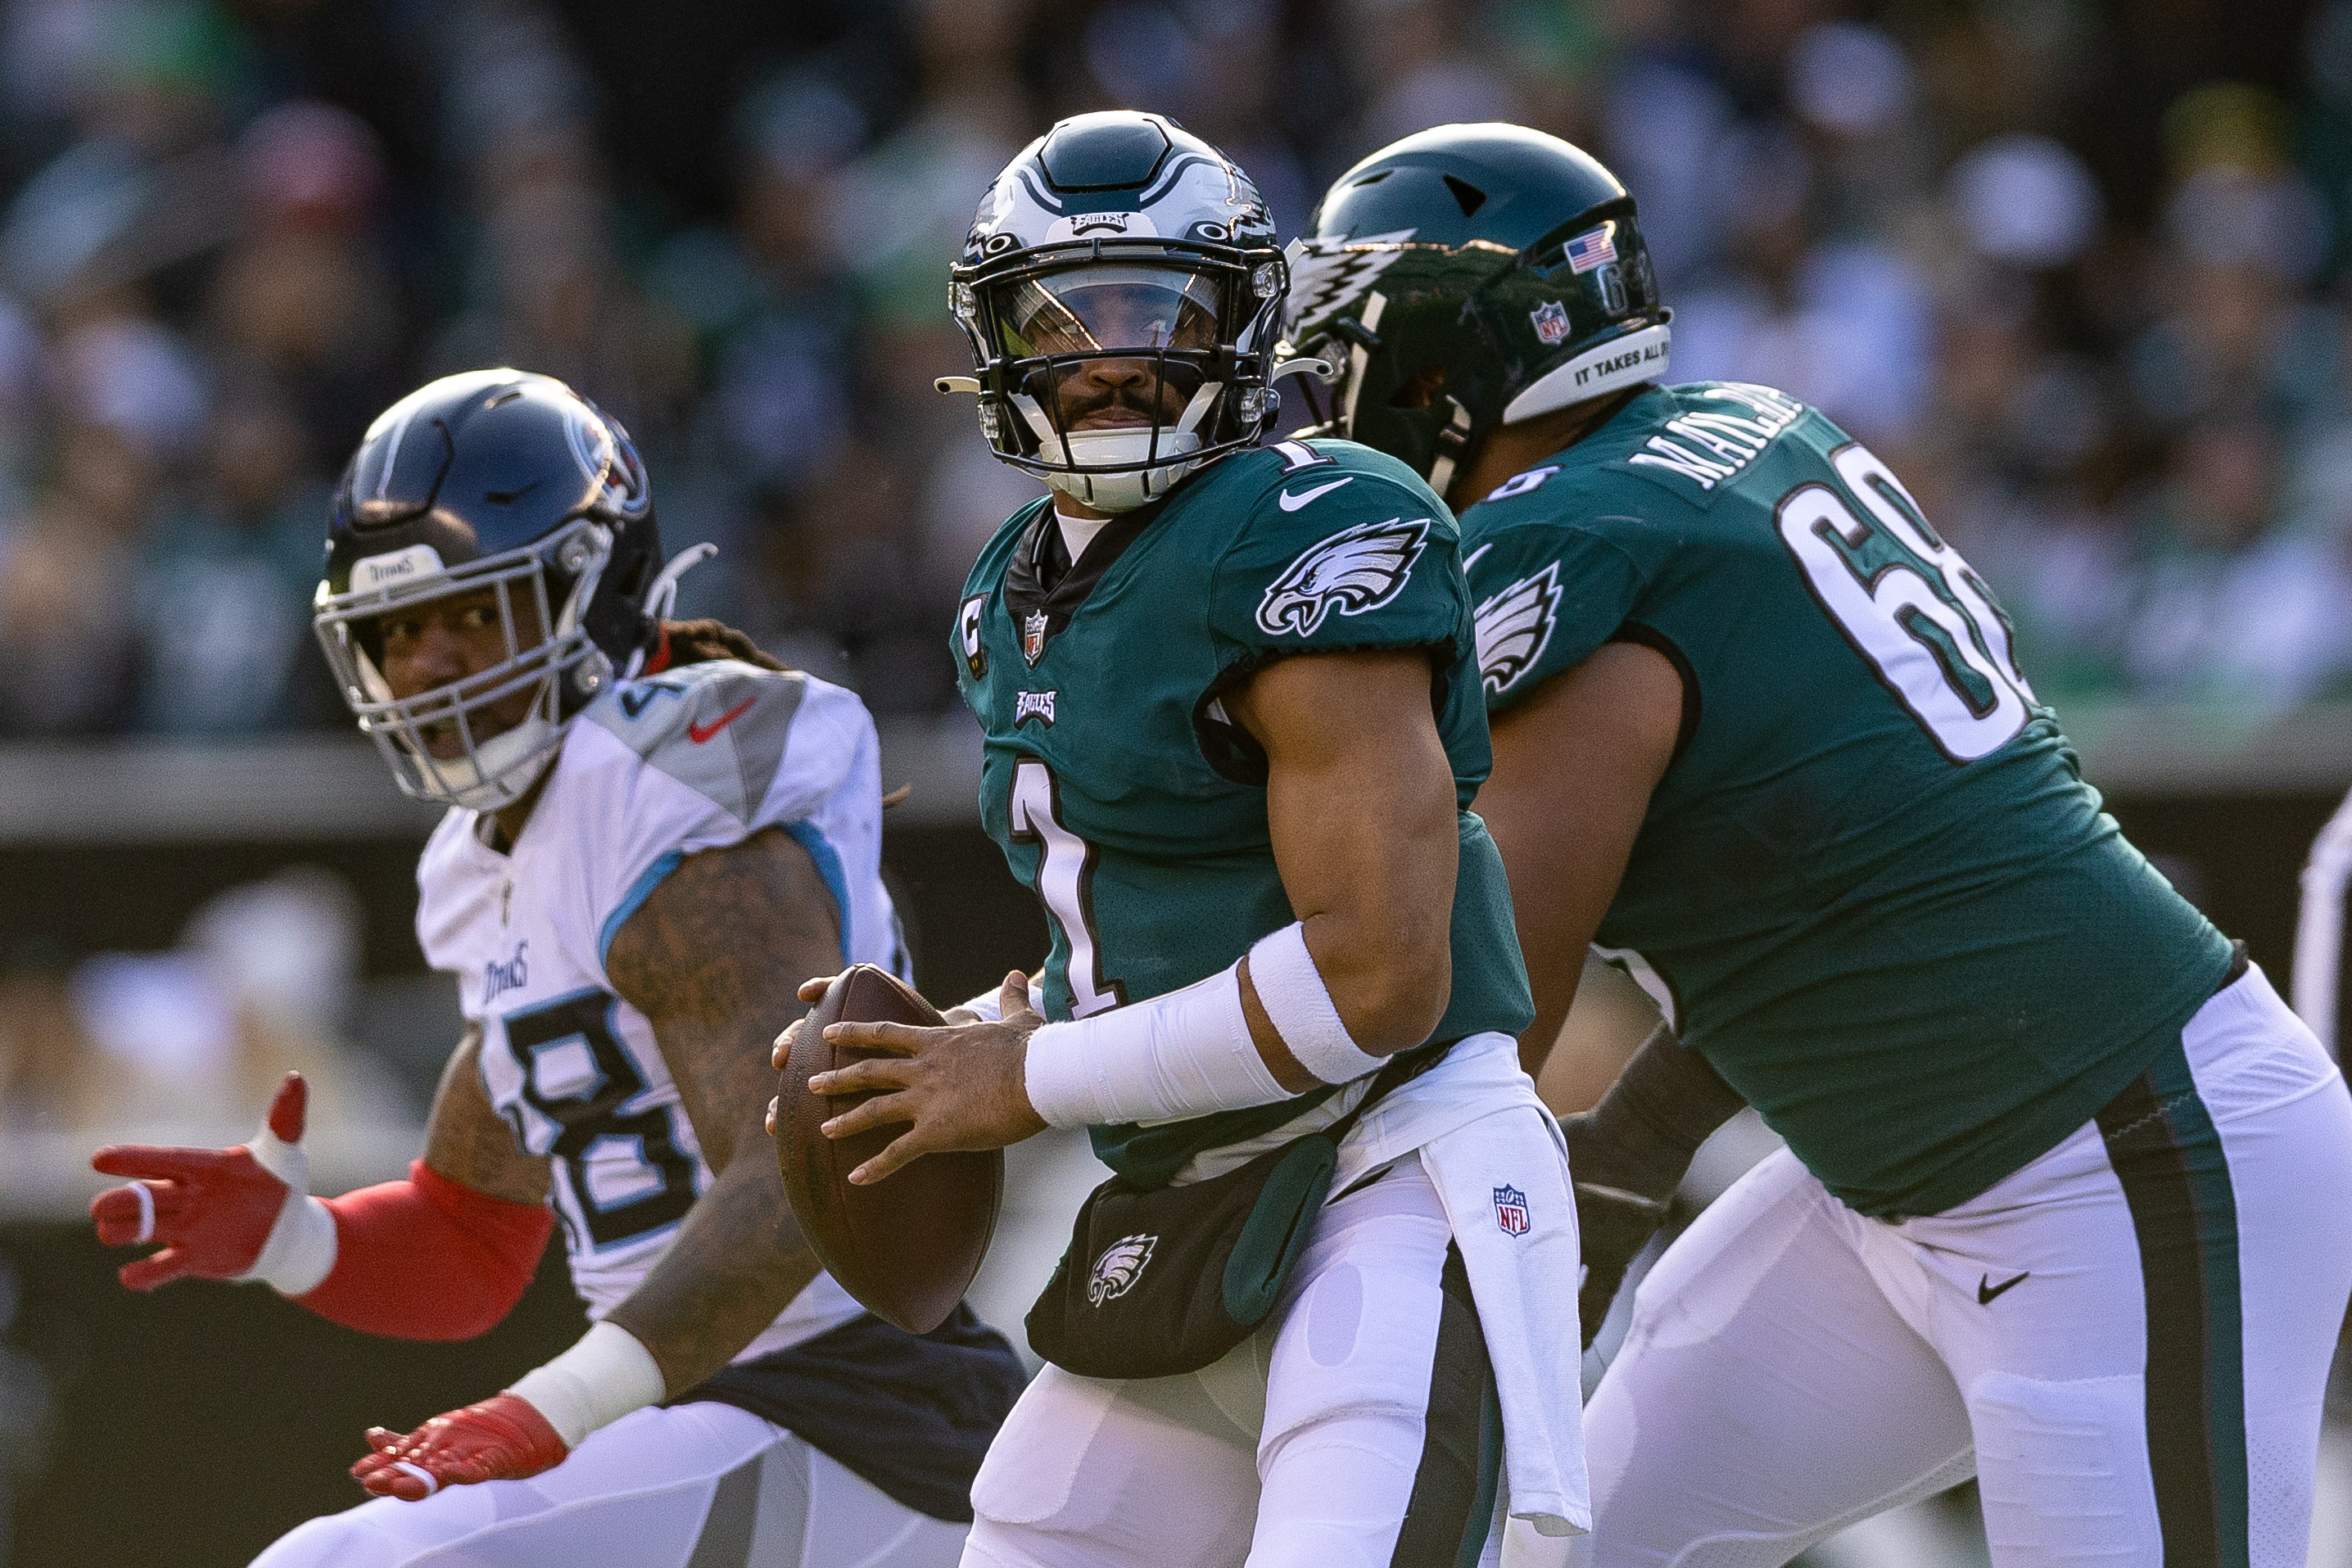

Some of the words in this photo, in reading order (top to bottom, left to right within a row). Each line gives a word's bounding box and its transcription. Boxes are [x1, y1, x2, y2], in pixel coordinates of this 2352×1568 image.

[1070, 213, 1129, 236] EAGLES
[1575, 367, 1590, 386] IT
[1594, 350, 1640, 377] TAKES
[1644, 345, 1659, 360] ALL
[961, 598, 982, 657] C
[1773, 441, 2042, 767] 68
[1015, 690, 1058, 727] EAGLES
[1006, 757, 1122, 1022] 1
[498, 987, 702, 1254] 8
[1498, 1205, 1528, 1233] NFL
